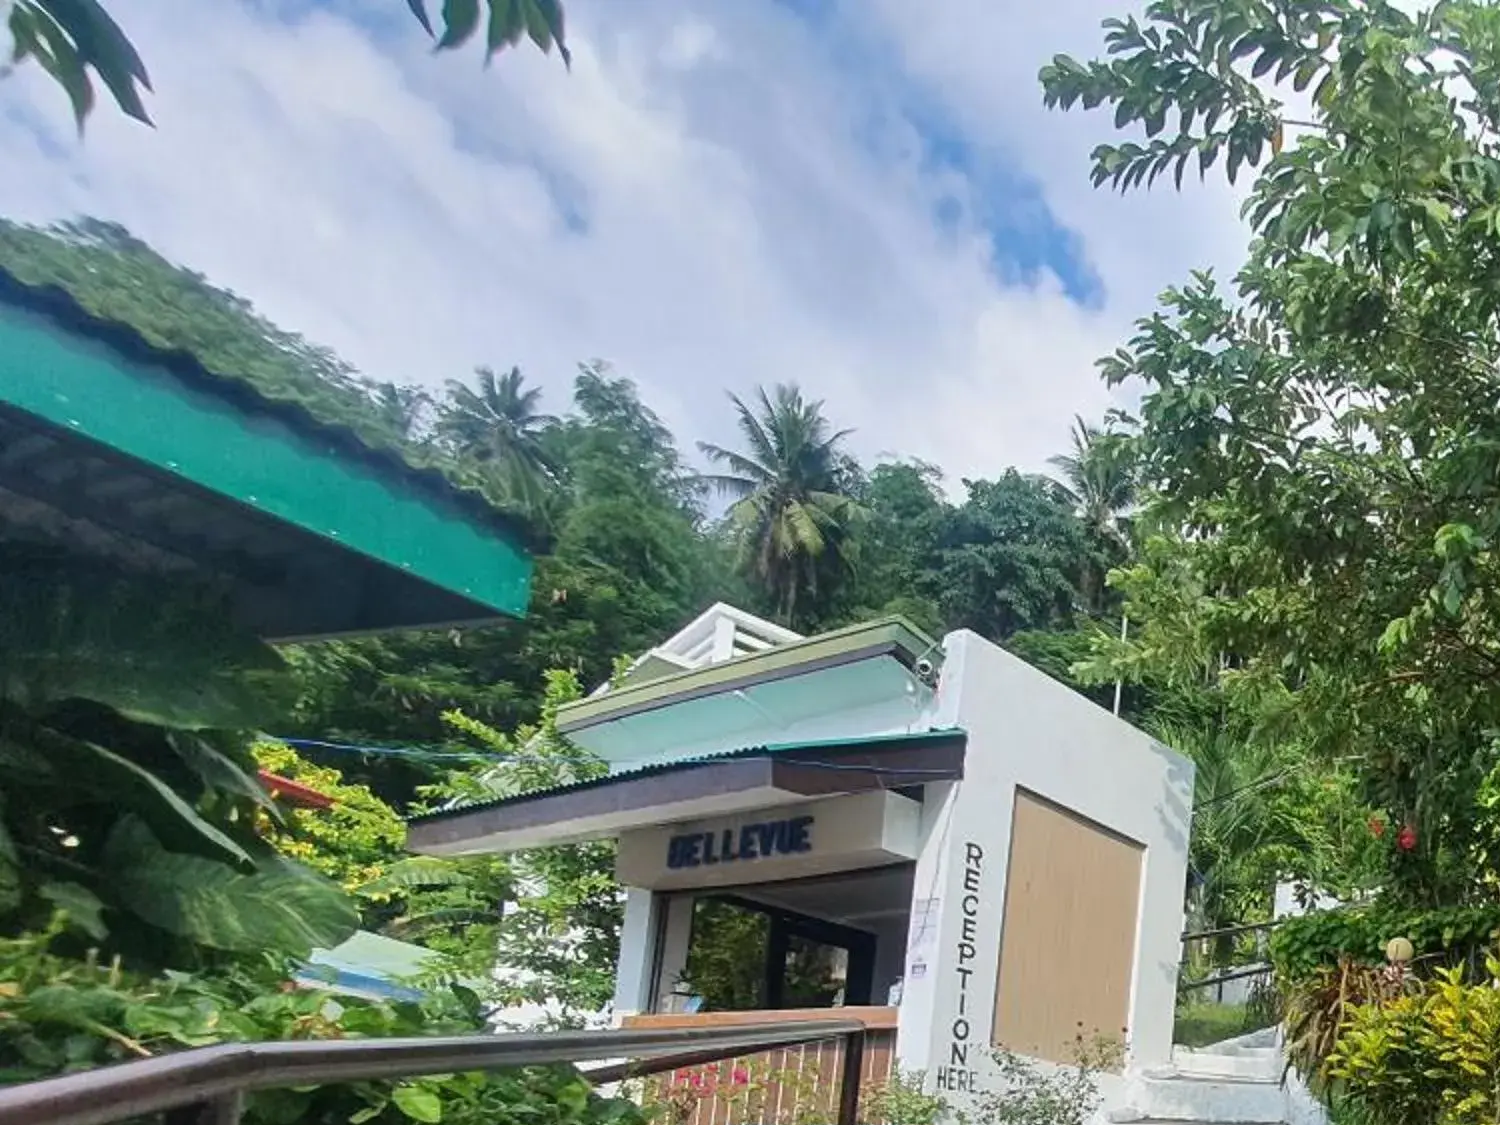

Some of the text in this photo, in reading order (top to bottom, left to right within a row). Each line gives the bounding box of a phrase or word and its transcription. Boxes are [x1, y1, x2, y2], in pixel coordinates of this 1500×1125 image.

[667, 815, 814, 869] BELLEVUE
[951, 842, 982, 1066] RECEPTION
[937, 1065, 979, 1093] HERE
